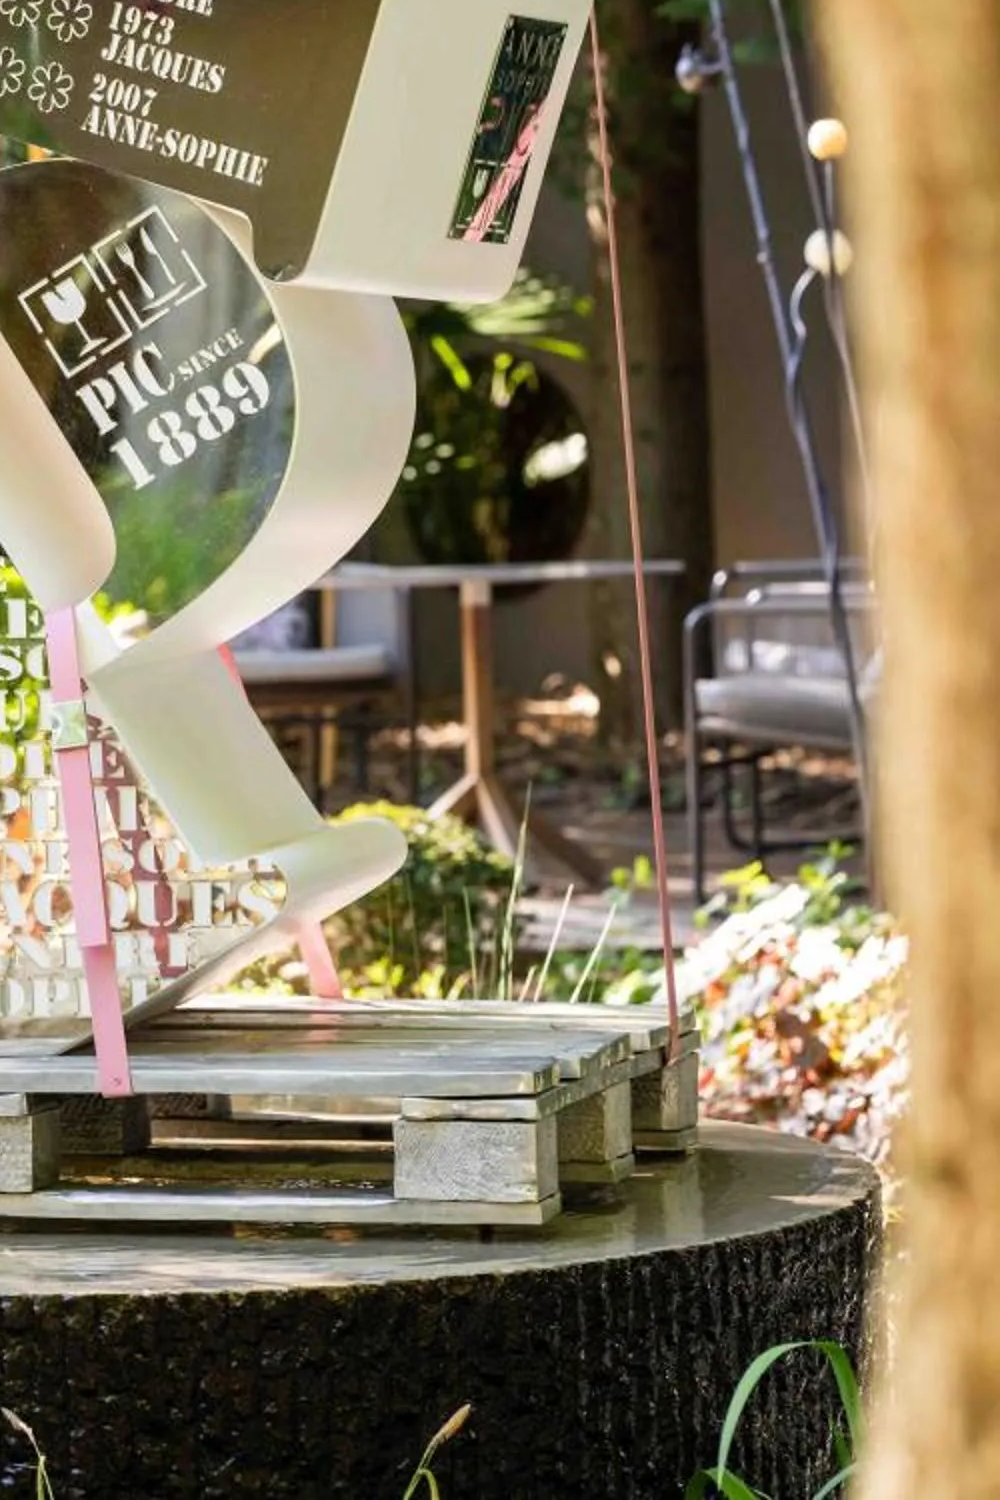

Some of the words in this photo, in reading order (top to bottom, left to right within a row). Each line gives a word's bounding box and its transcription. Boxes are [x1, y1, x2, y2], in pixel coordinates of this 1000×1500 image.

[108, 1, 176, 46] 1973
[88, 72, 159, 117] 2007
[100, 33, 227, 94] JACQUES
[79, 105, 270, 188] ANNE-SOPHIE
[75, 341, 176, 437] PIC
[176, 327, 246, 382] SINCE
[109, 361, 271, 491] 1889
